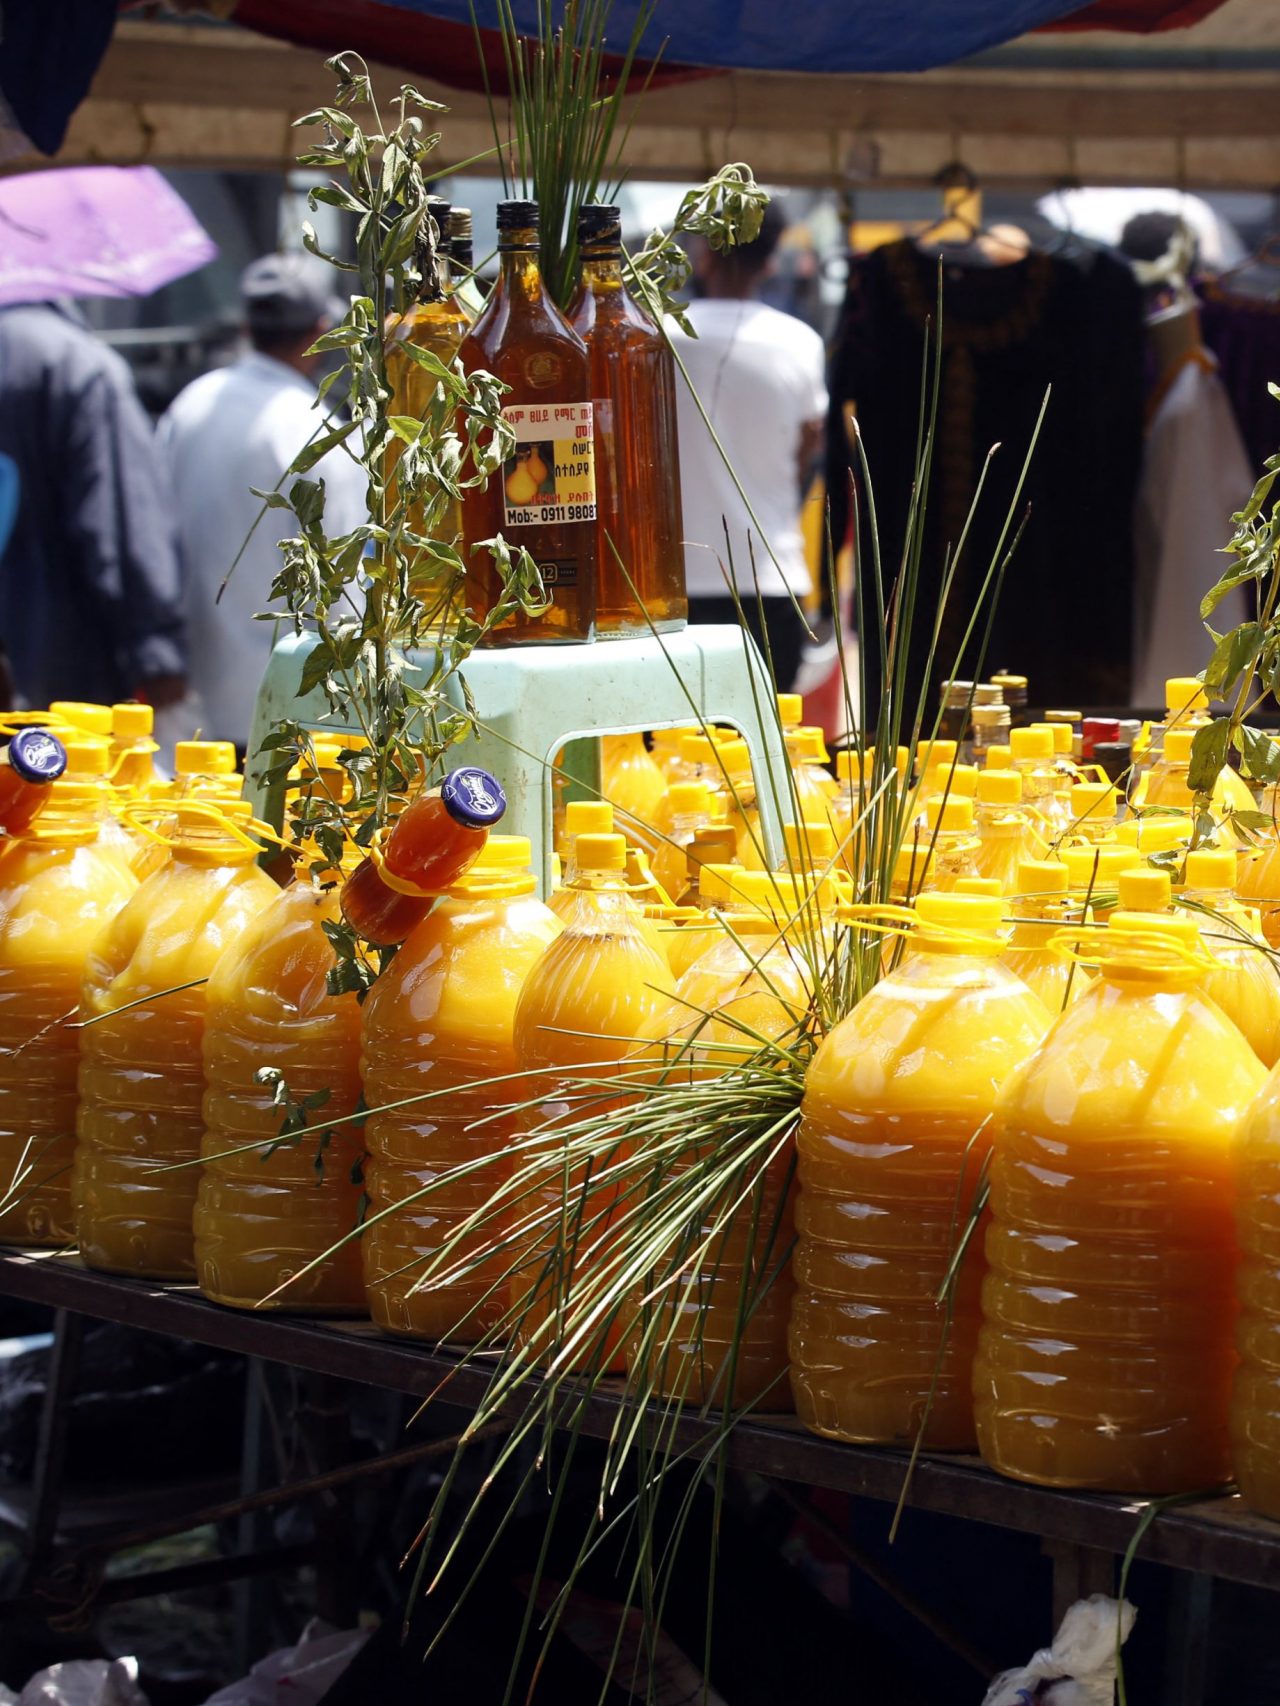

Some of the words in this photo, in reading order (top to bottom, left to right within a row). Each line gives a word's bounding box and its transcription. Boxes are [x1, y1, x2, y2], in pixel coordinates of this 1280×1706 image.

[508, 508, 539, 524] Mob:-
[541, 507, 565, 521] 0911
[542, 567, 554, 579] 12
